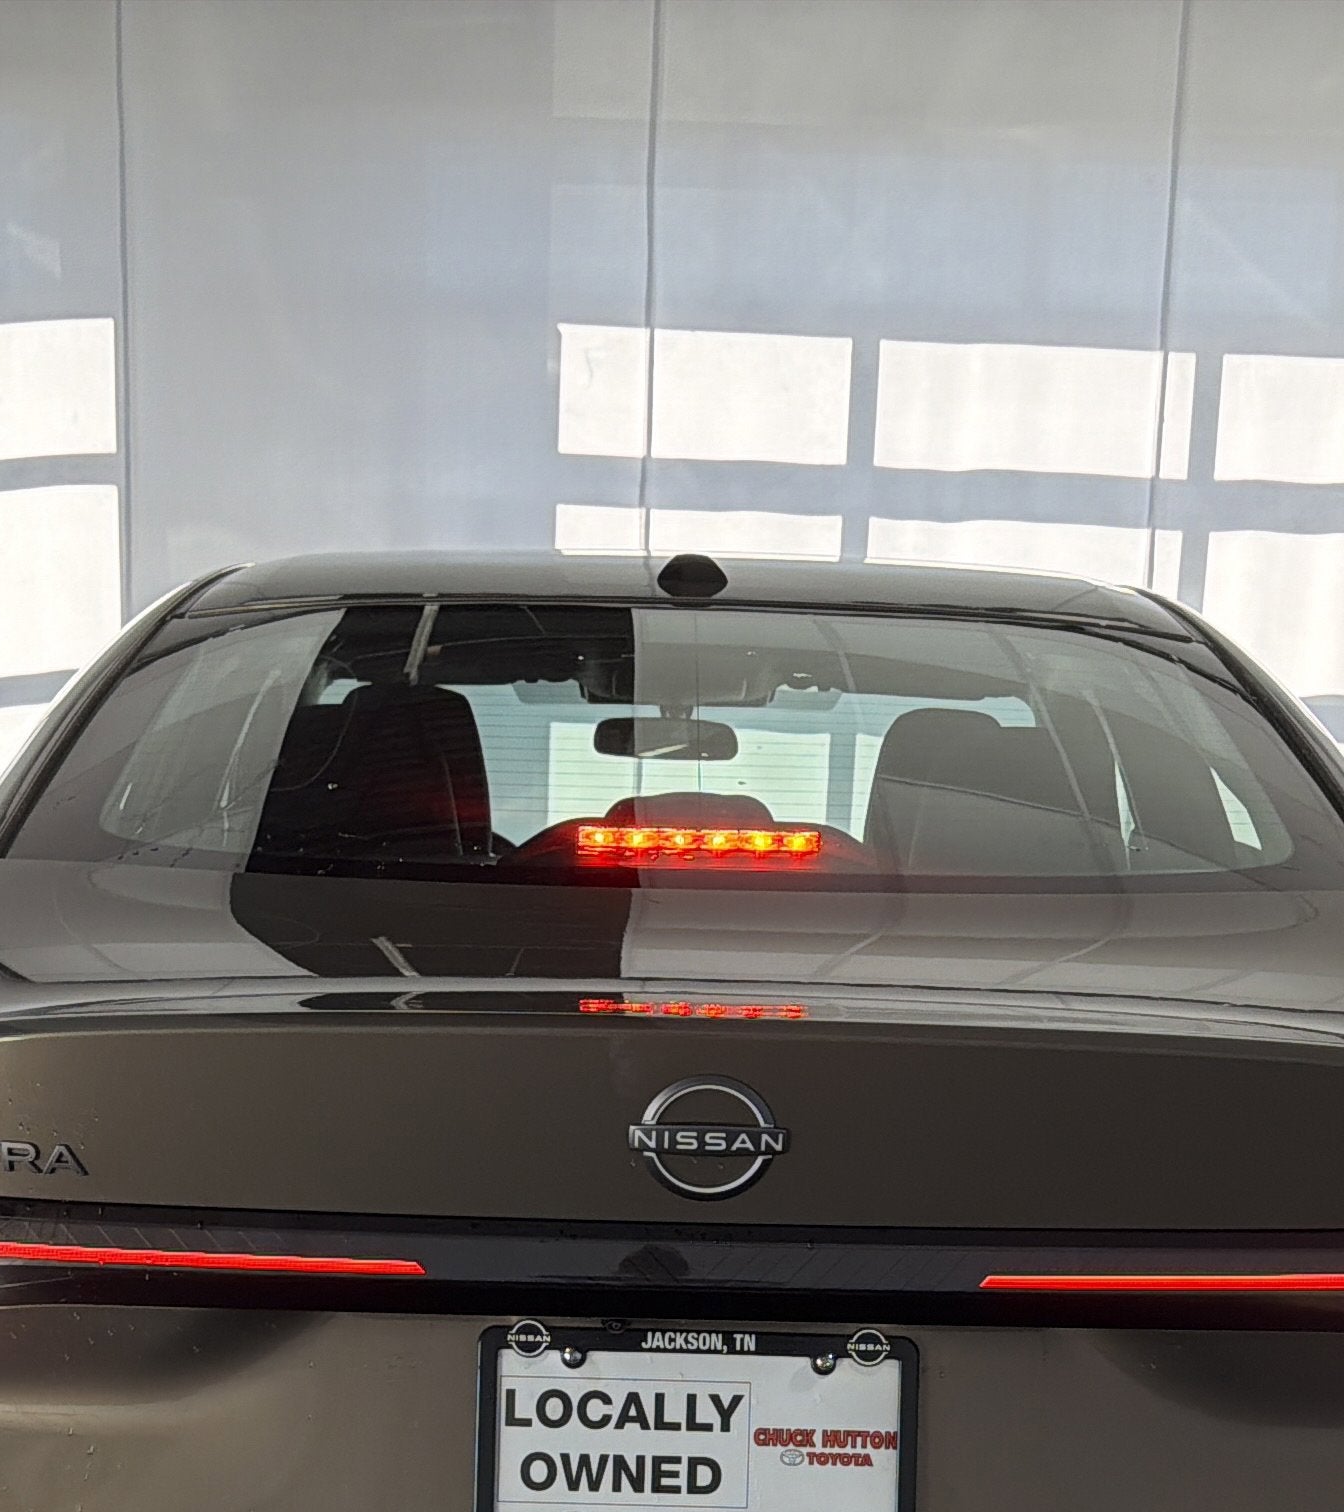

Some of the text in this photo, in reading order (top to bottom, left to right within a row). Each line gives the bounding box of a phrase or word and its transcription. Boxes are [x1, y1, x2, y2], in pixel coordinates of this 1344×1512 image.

[634, 1129, 784, 1152] NISSAN
[507, 1331, 551, 1344] NISSAN
[641, 1332, 757, 1354] JACKSON, TN
[847, 1341, 891, 1353] NISSAN
[504, 1388, 745, 1433] LOCALLY
[753, 1428, 898, 1450] CHUCK HUTTON
[806, 1452, 874, 1467] TOYOTA
[520, 1452, 723, 1495] OWNED
